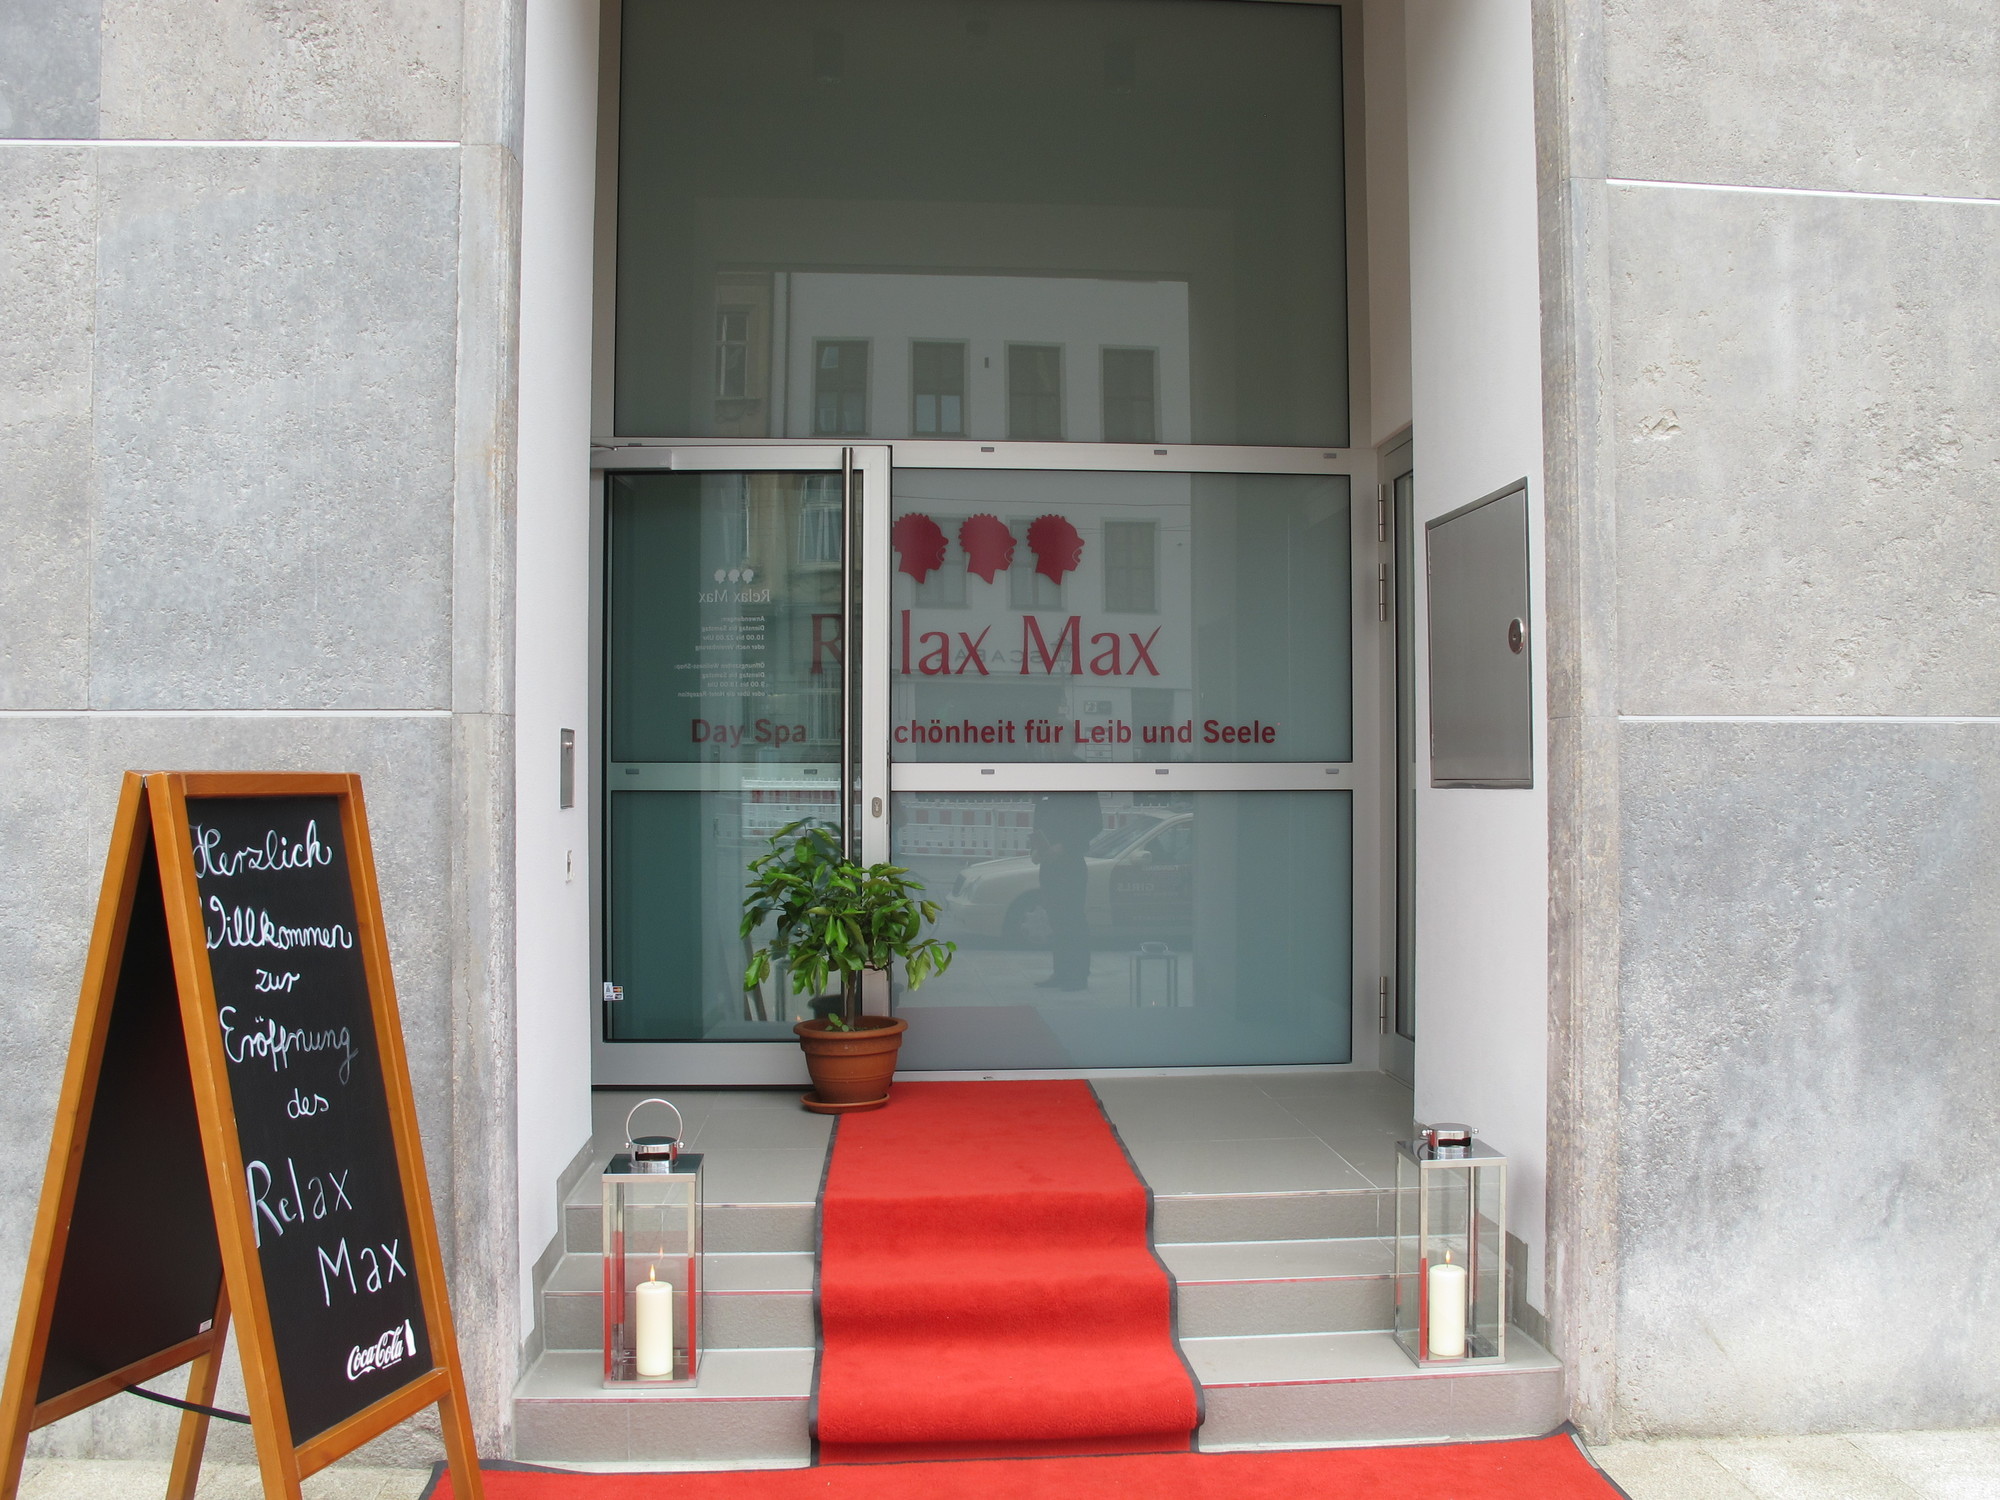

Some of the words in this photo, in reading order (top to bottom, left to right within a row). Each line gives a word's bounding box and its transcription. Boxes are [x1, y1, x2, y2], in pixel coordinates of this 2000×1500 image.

[811, 609, 991, 676] Rlax
[1019, 615, 1162, 676] Max
[691, 719, 744, 748] Day
[754, 718, 807, 748] Spa
[894, 719, 1015, 743] chönheit
[1024, 719, 1063, 743] für
[1074, 719, 1132, 743] Leib
[1142, 719, 1192, 743] und
[1203, 719, 1276, 743] Seele
[190, 820, 333, 878] Herzlich
[255, 969, 300, 992] zur
[219, 1005, 358, 1085] Eröffnung
[287, 1087, 330, 1119] des
[246, 1157, 352, 1248] Relax
[317, 1237, 406, 1307] Max
